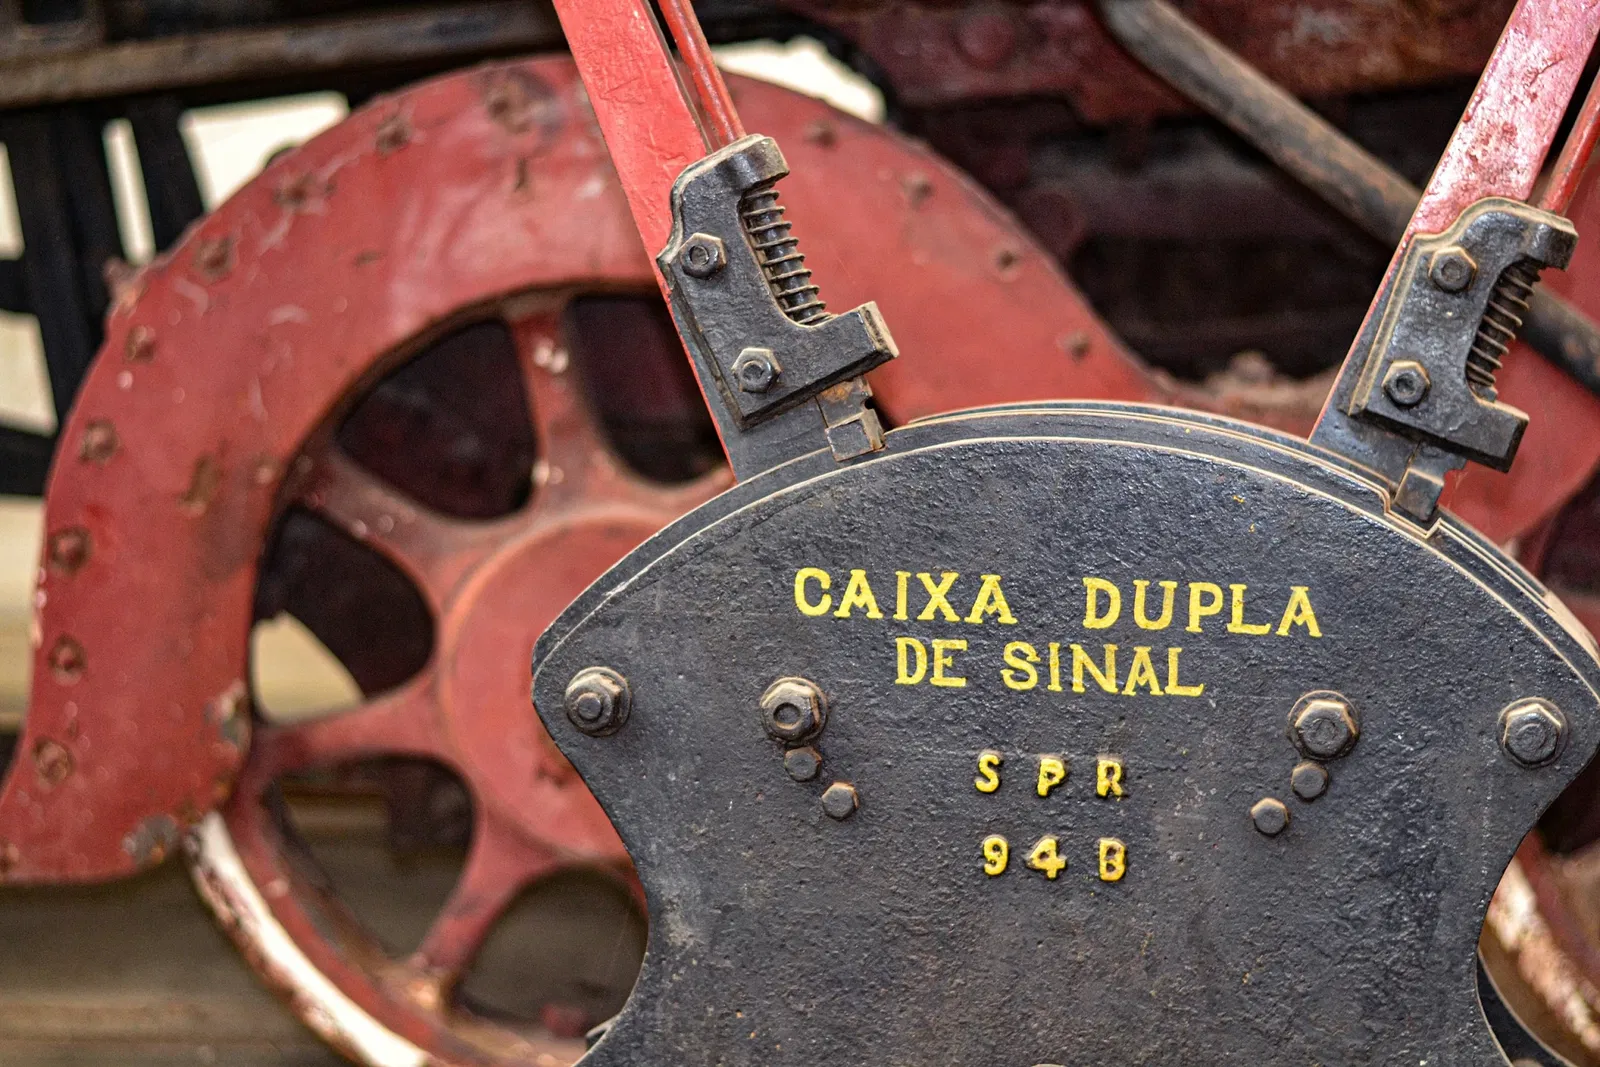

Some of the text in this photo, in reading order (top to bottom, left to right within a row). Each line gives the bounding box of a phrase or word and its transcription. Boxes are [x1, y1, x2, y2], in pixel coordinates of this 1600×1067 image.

[793, 566, 1322, 638] CAIXA DUPLA
[894, 636, 1205, 698] DE SINAL
